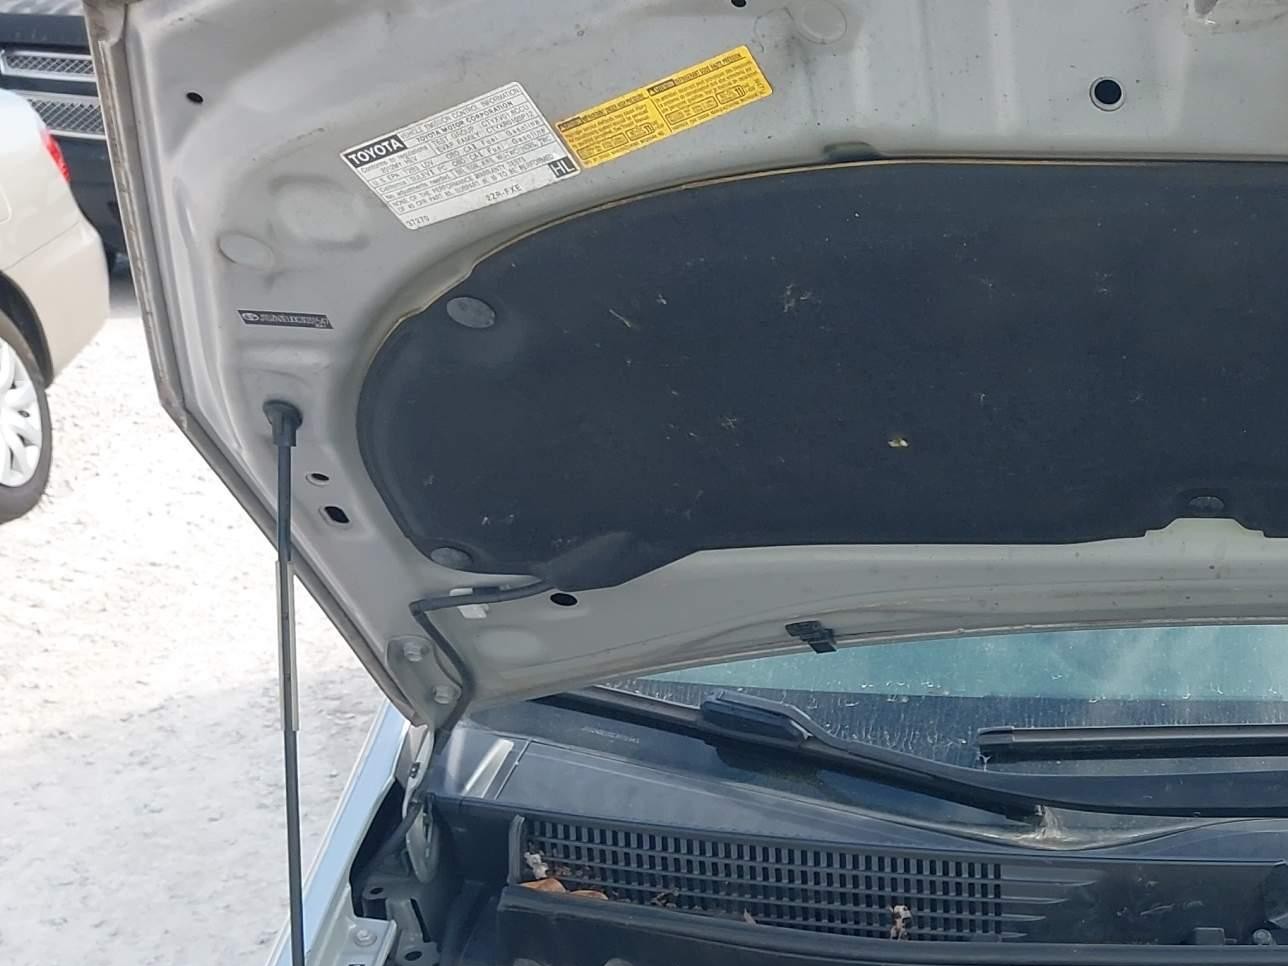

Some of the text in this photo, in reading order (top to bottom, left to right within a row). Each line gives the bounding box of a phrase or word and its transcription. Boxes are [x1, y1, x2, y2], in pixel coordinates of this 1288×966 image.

[416, 101, 514, 142] TOYOTA MOTOR CORPORATION
[348, 137, 404, 165] TOYOTA
[549, 158, 576, 176] HL
